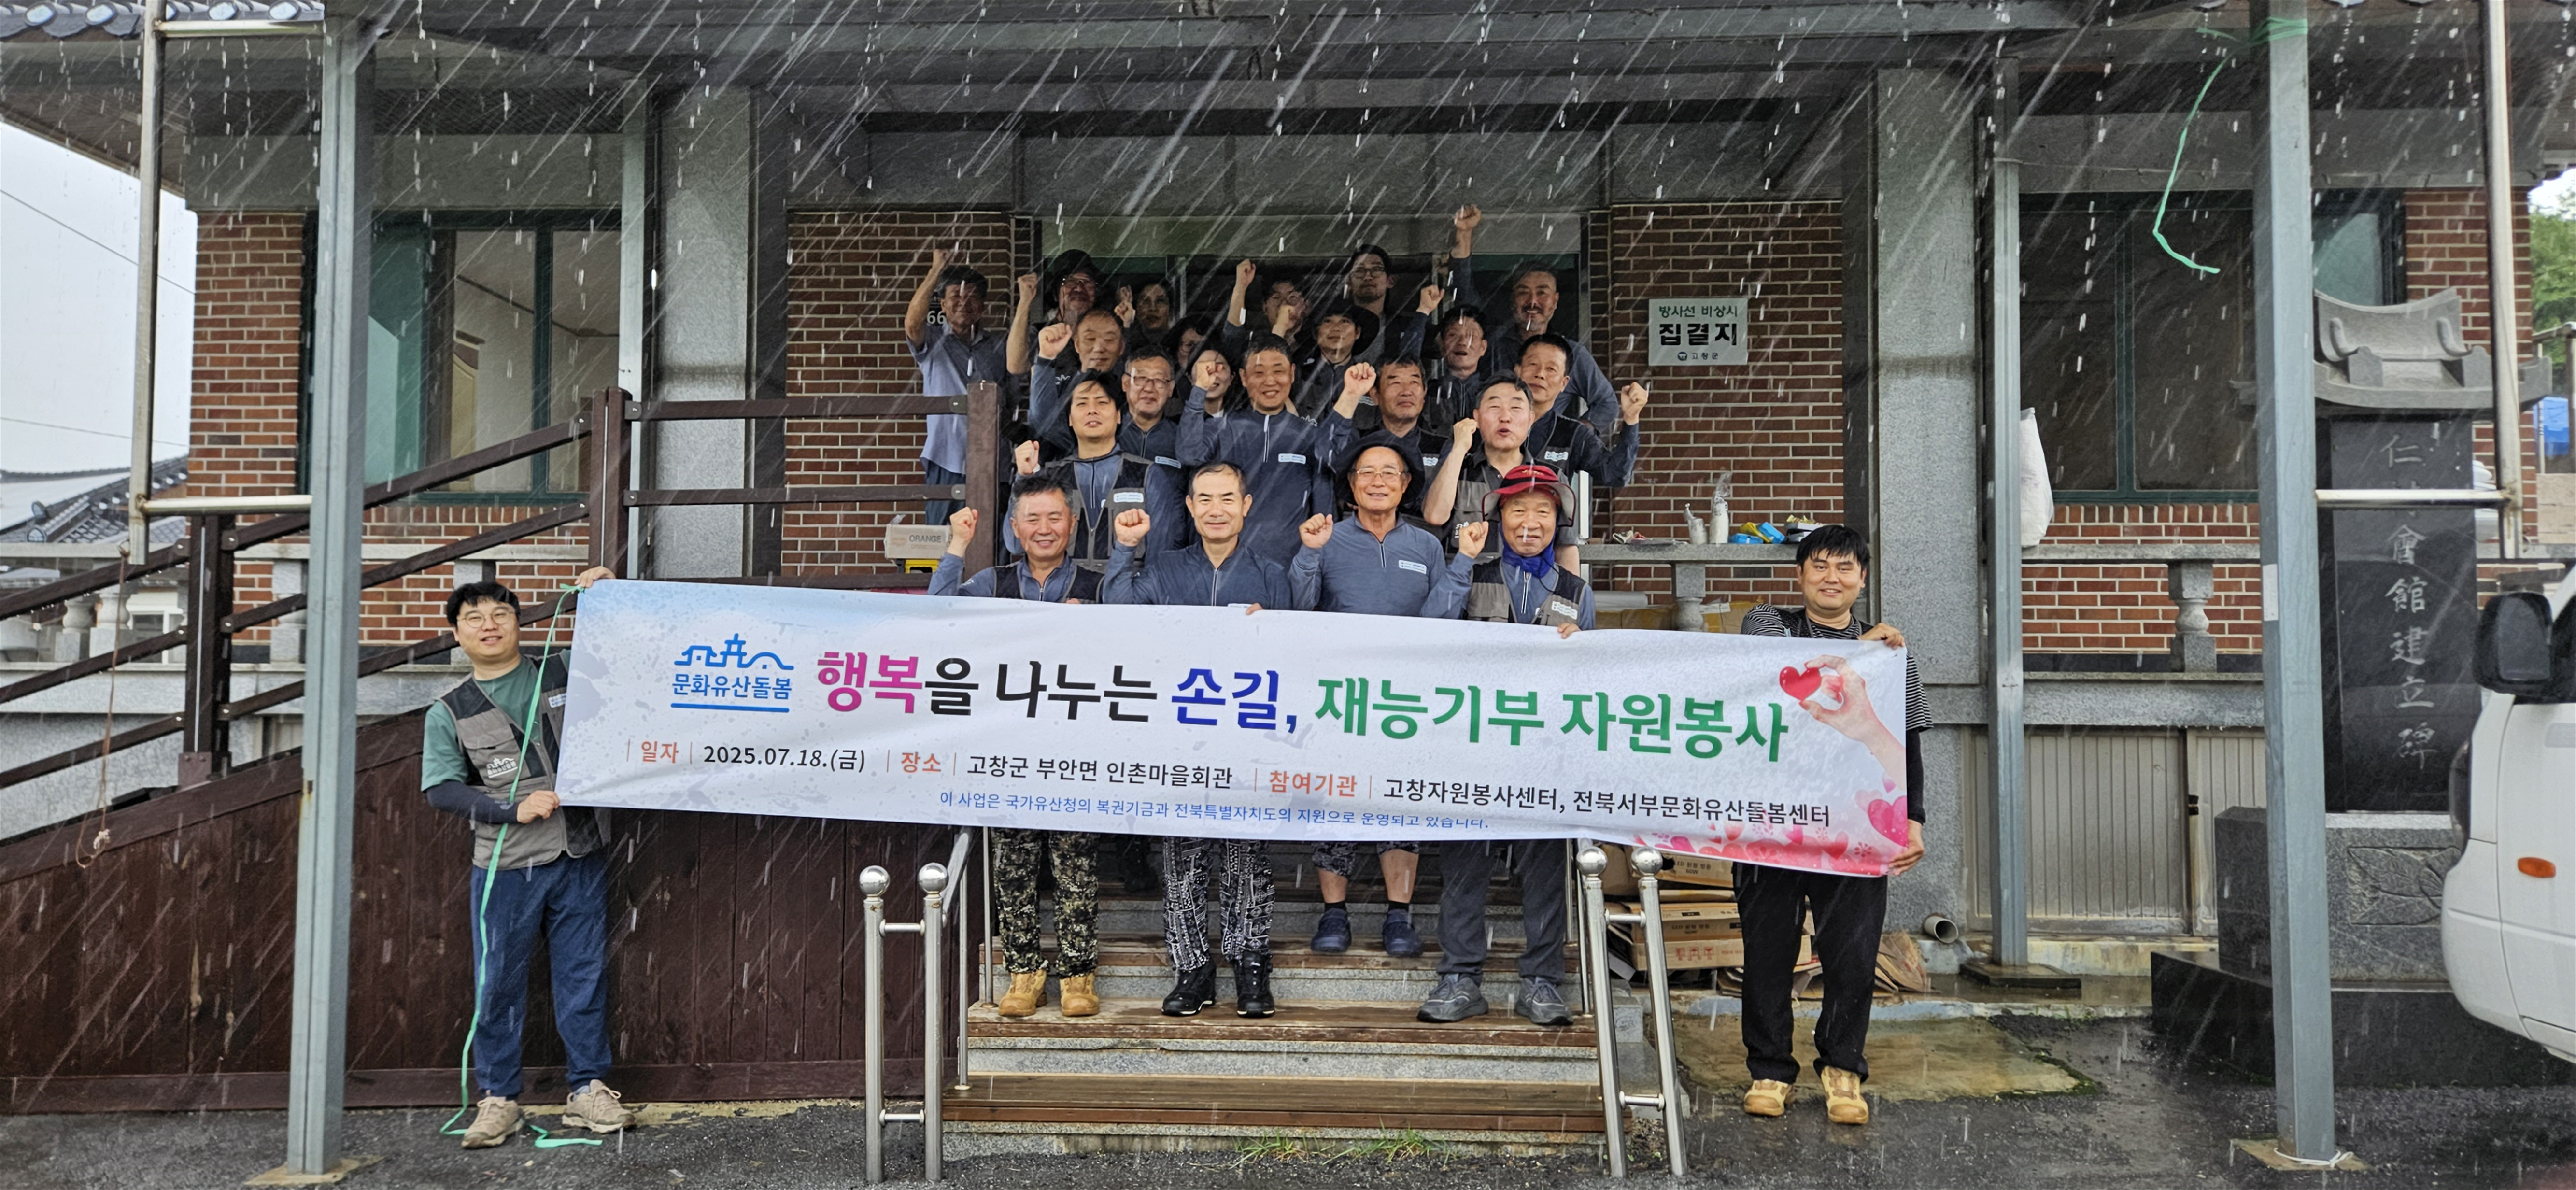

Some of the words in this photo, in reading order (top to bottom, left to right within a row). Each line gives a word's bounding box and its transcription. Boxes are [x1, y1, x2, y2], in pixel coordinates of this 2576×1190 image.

[927, 310, 946, 324] 66
[1659, 306, 1695, 318] 방사선
[1701, 306, 1738, 317] 비상시
[1659, 323, 1737, 346] 집결지
[909, 535, 941, 543] ORANGE
[2380, 434, 2438, 769] 仁會館建立碑
[673, 674, 792, 700] 문화유산돌봄
[817, 652, 979, 716] 행복을
[997, 661, 1158, 722] 나누는
[1172, 669, 1297, 734] 손길,
[1315, 677, 1545, 746] 재능기부
[1561, 690, 1789, 763] 자원봉사
[641, 741, 679, 764] 일자
[705, 746, 864, 773] 2025.07.18.(금)
[902, 752, 941, 773] 장소
[968, 756, 1029, 778] 고창군
[1037, 759, 1097, 782] 부안면
[1108, 763, 1233, 789] 인촌마을회관
[1269, 770, 1358, 797] 참여기관
[1384, 779, 1565, 815] 고창자원봉사센터,
[1573, 793, 1831, 828] 전북서부문화유산돌봄센터
[940, 791, 952, 807] 이
[959, 793, 1000, 808] 사업은
[1007, 796, 1090, 813] 국가유산청의
[1098, 801, 1168, 817] 복권기금과
[1176, 805, 1291, 822] 전북특별자치도의
[1299, 810, 1354, 823] 지원으로
[1362, 814, 1418, 826] 운영되고
[1426, 816, 1488, 829] 있습니다.
